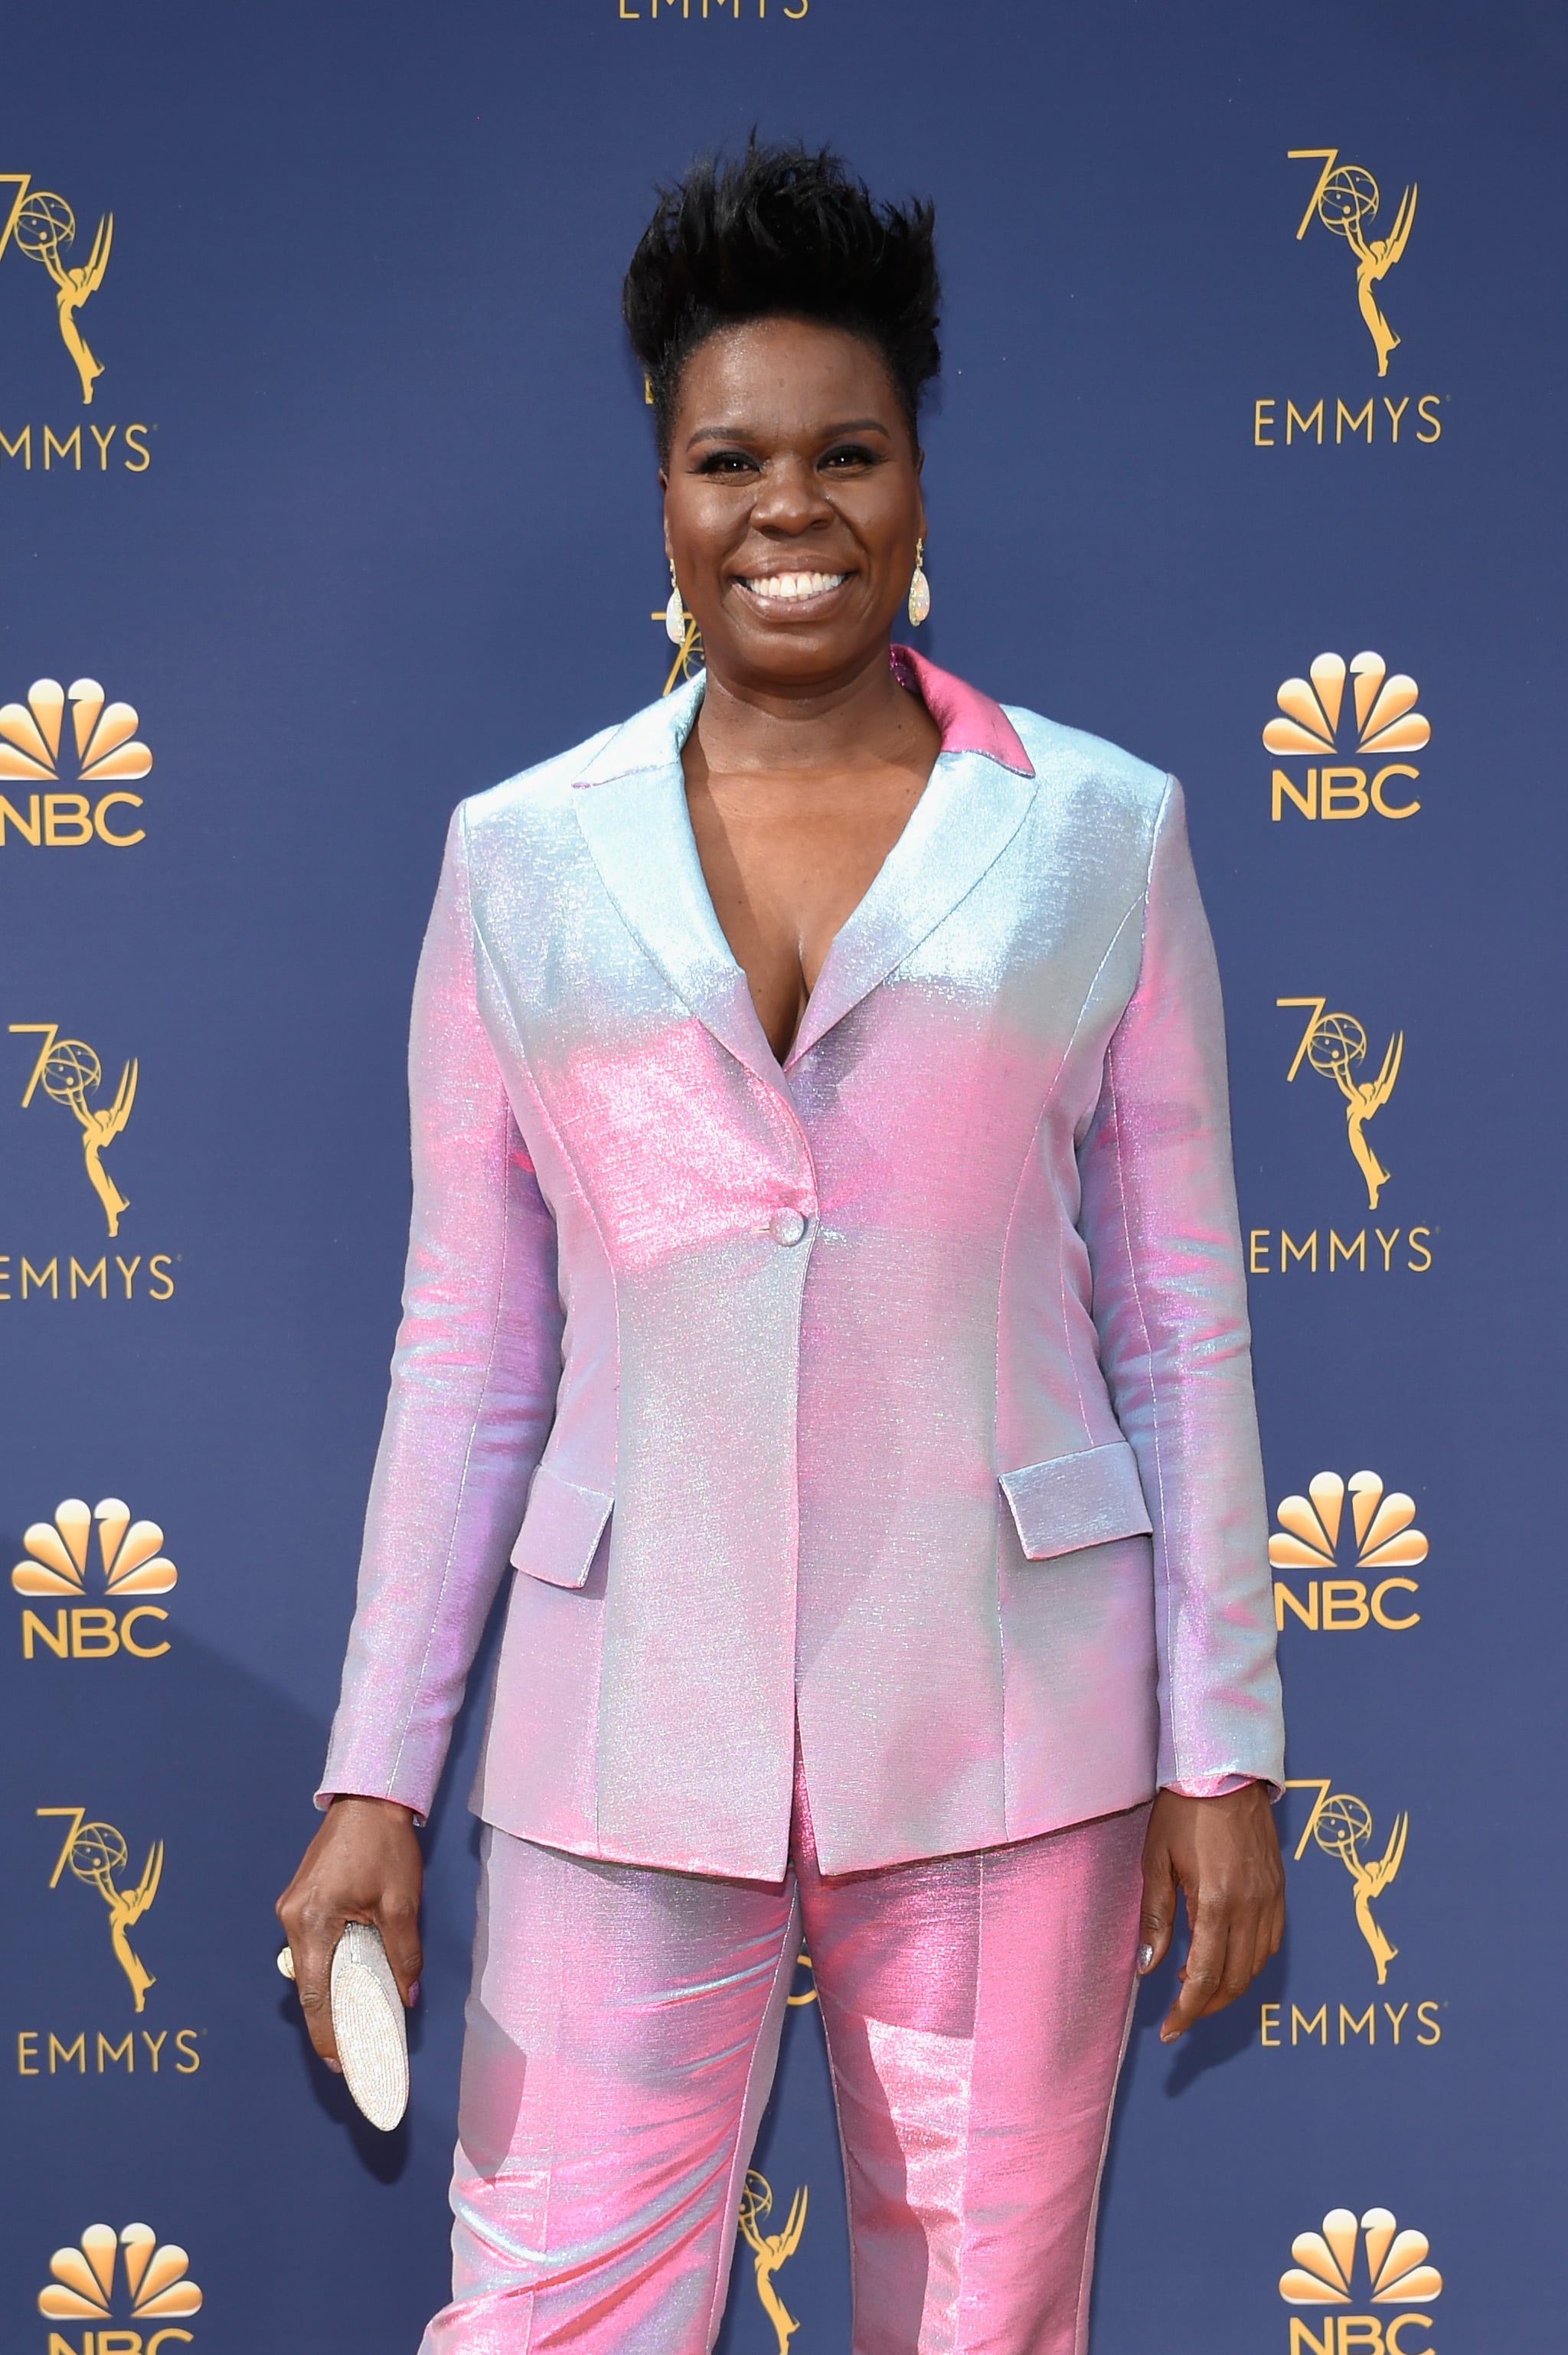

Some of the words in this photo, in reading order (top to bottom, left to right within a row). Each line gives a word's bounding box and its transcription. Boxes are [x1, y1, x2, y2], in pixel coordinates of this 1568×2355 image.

[1254, 394, 1442, 445] EMMYS
[1271, 763, 1421, 821] NBC
[0, 791, 146, 847] NBC
[1250, 1226, 1432, 1273] EMMYS
[1276, 1577, 1421, 1632] NBC
[21, 1605, 172, 1659] NBC
[1260, 2001, 1441, 2046] EMMYS
[18, 2030, 200, 2074] EMMYS
[1289, 2313, 1436, 2355] NBC
